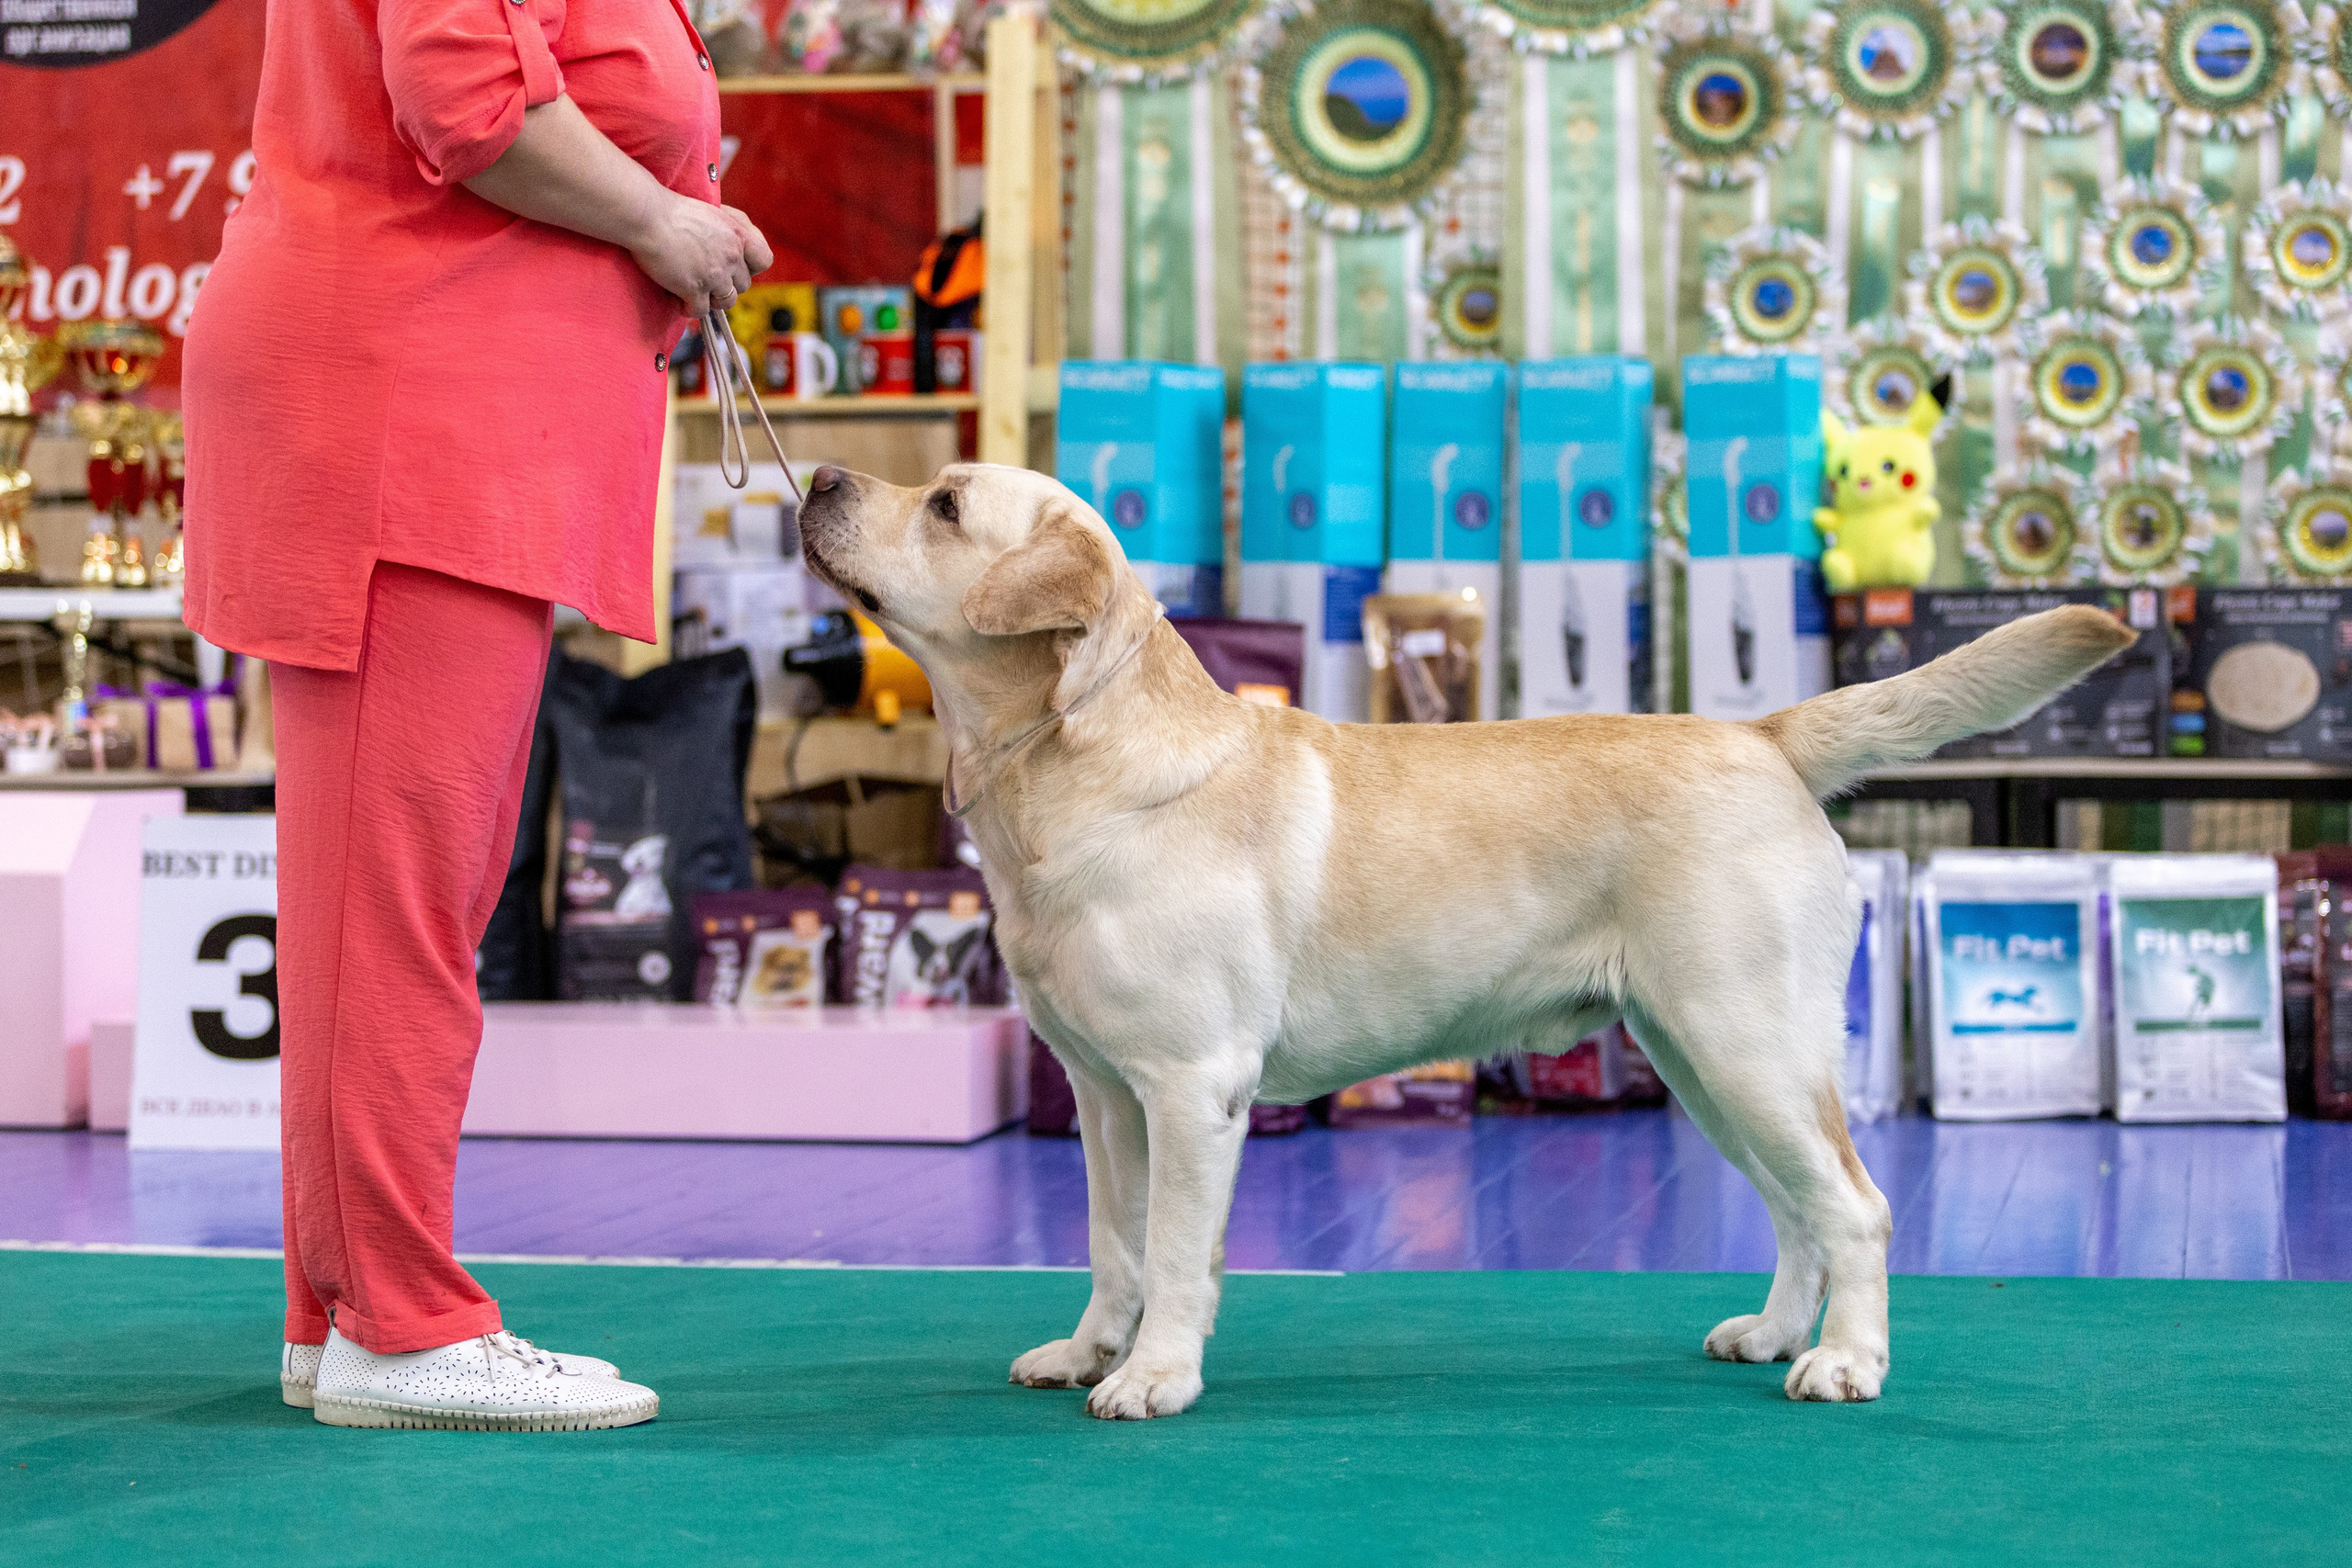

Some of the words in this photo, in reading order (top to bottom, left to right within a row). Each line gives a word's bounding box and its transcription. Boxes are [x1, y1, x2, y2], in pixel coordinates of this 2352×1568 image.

[122, 149, 216, 222] +7
[142, 850, 226, 879] BEST
[2188, 929, 2251, 957] Pet
[190, 913, 280, 1064] 3
